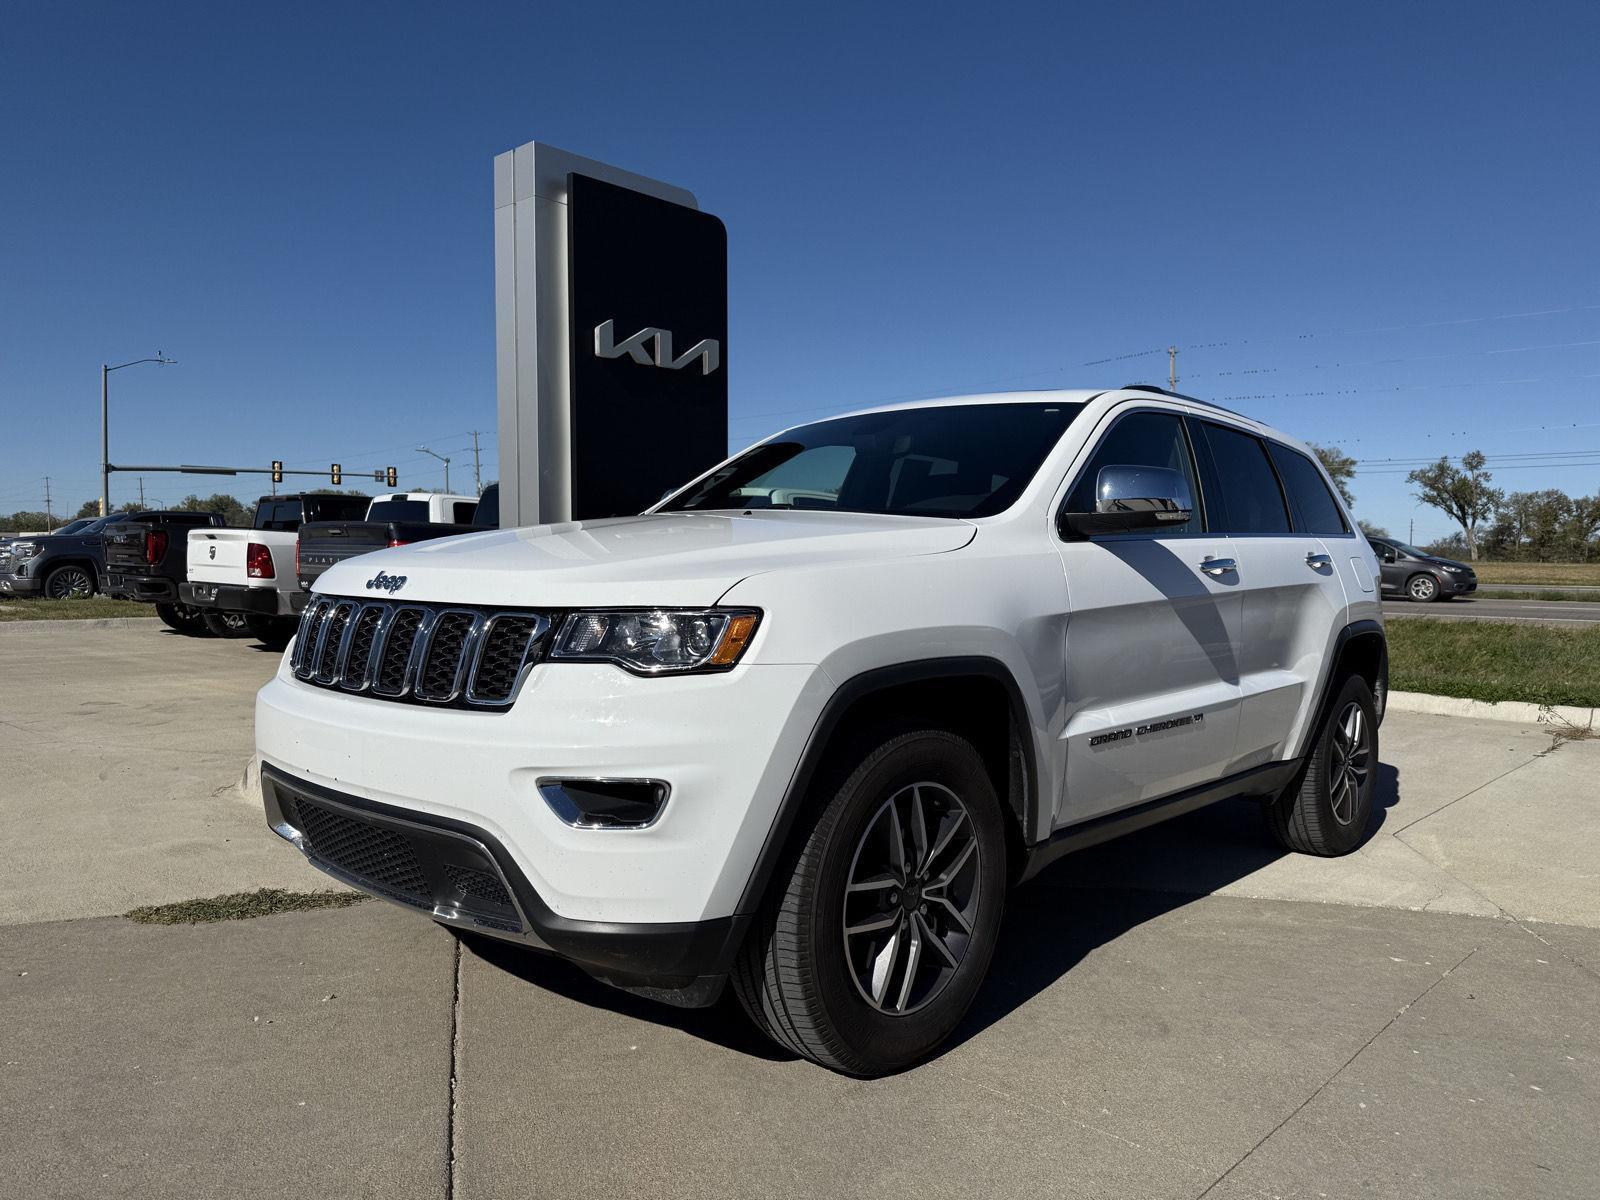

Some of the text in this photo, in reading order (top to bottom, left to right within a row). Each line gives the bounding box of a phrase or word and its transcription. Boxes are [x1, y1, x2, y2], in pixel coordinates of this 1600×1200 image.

[594, 319, 720, 375] KIA
[365, 570, 408, 595] Jeep
[1088, 715, 1194, 747] GRAND CHEROKEE
